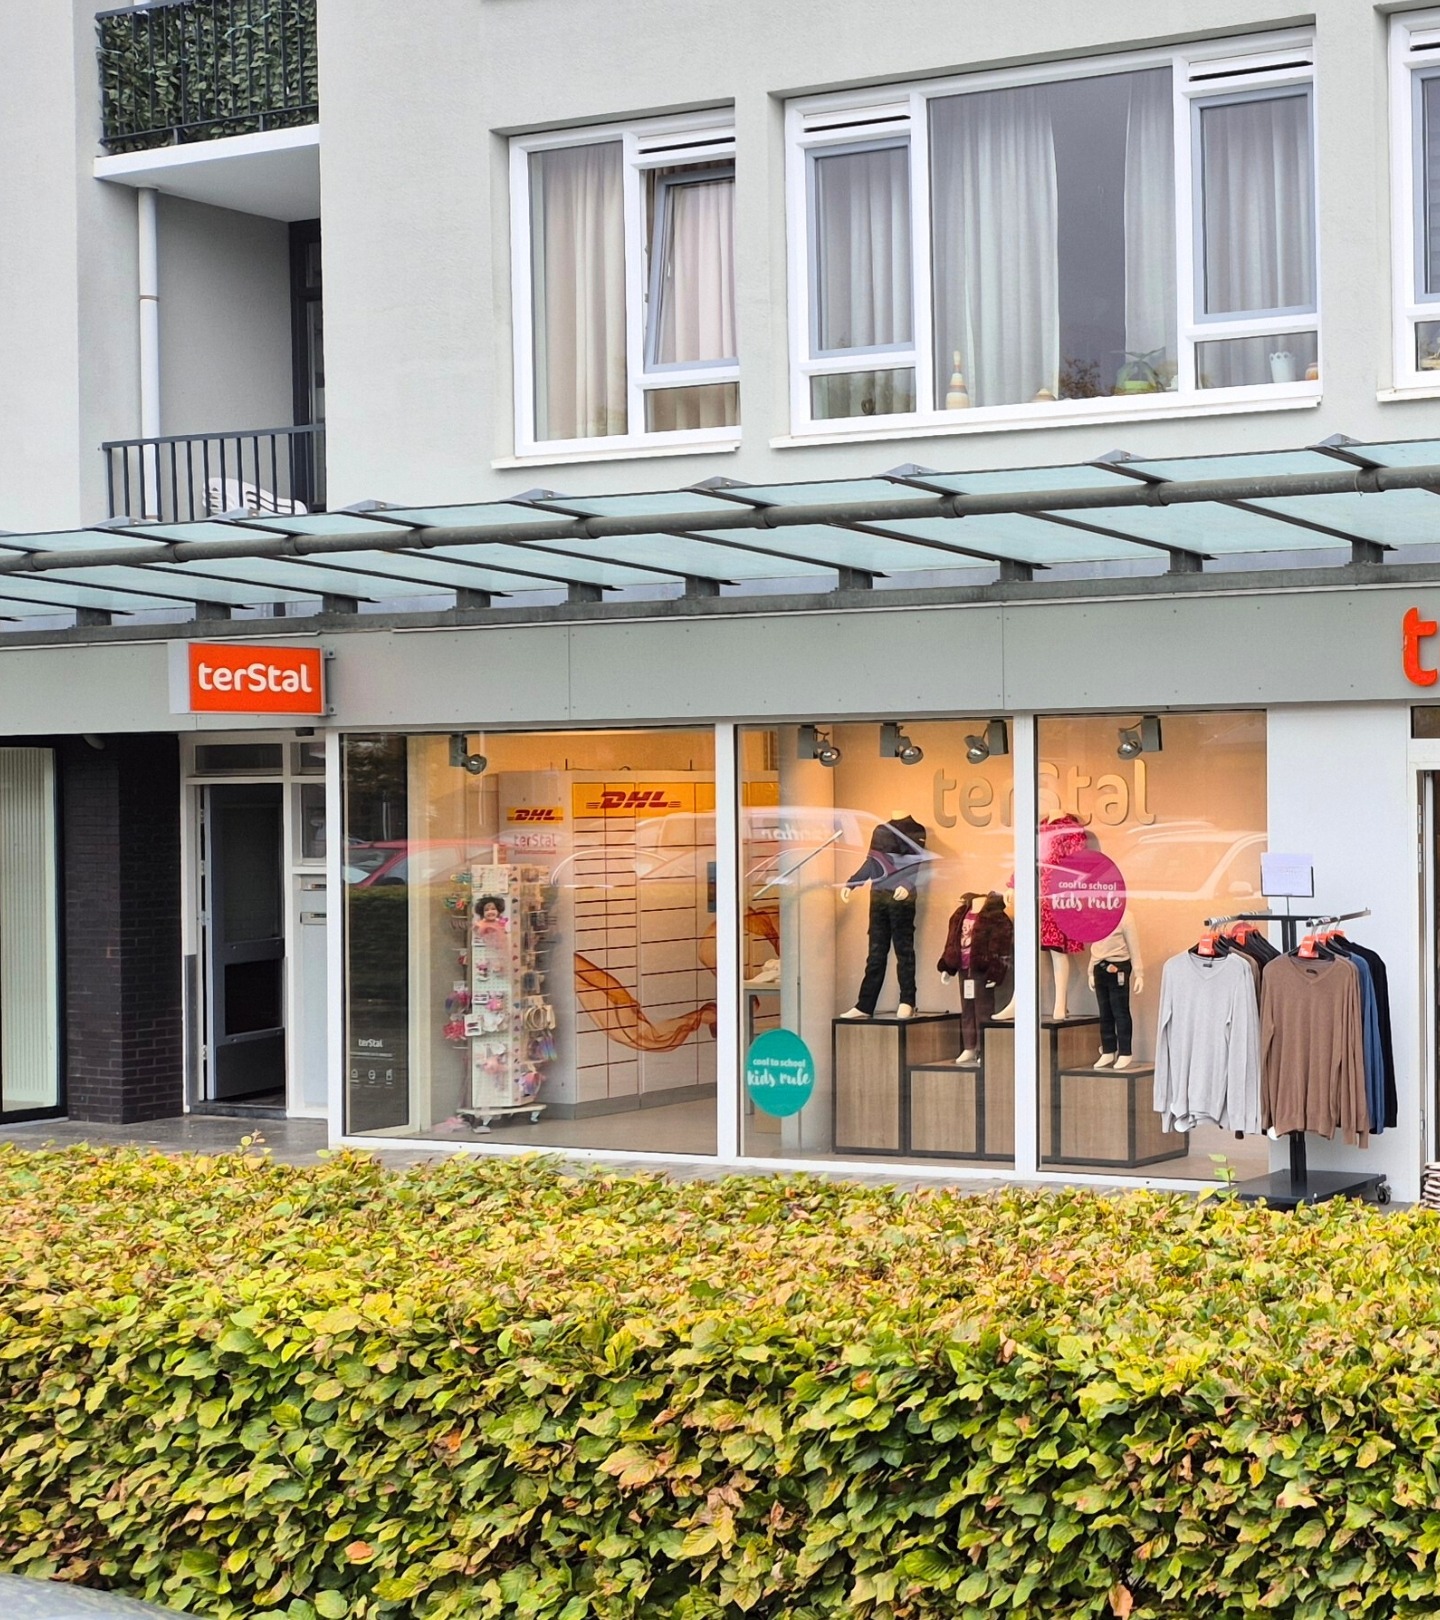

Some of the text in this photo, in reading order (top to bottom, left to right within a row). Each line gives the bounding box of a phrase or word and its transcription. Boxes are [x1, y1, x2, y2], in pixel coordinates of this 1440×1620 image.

[198, 662, 313, 693] terStal
[600, 791, 669, 809] DHL
[514, 809, 555, 821] DHL
[513, 833, 557, 847] terStal
[1058, 881, 1077, 889] cool
[1088, 880, 1117, 891] school
[1051, 890, 1122, 911] kids rule
[358, 1038, 384, 1048] terStal
[752, 1057, 770, 1067] cool
[780, 1058, 806, 1068] school
[747, 1067, 812, 1088] kids rule
